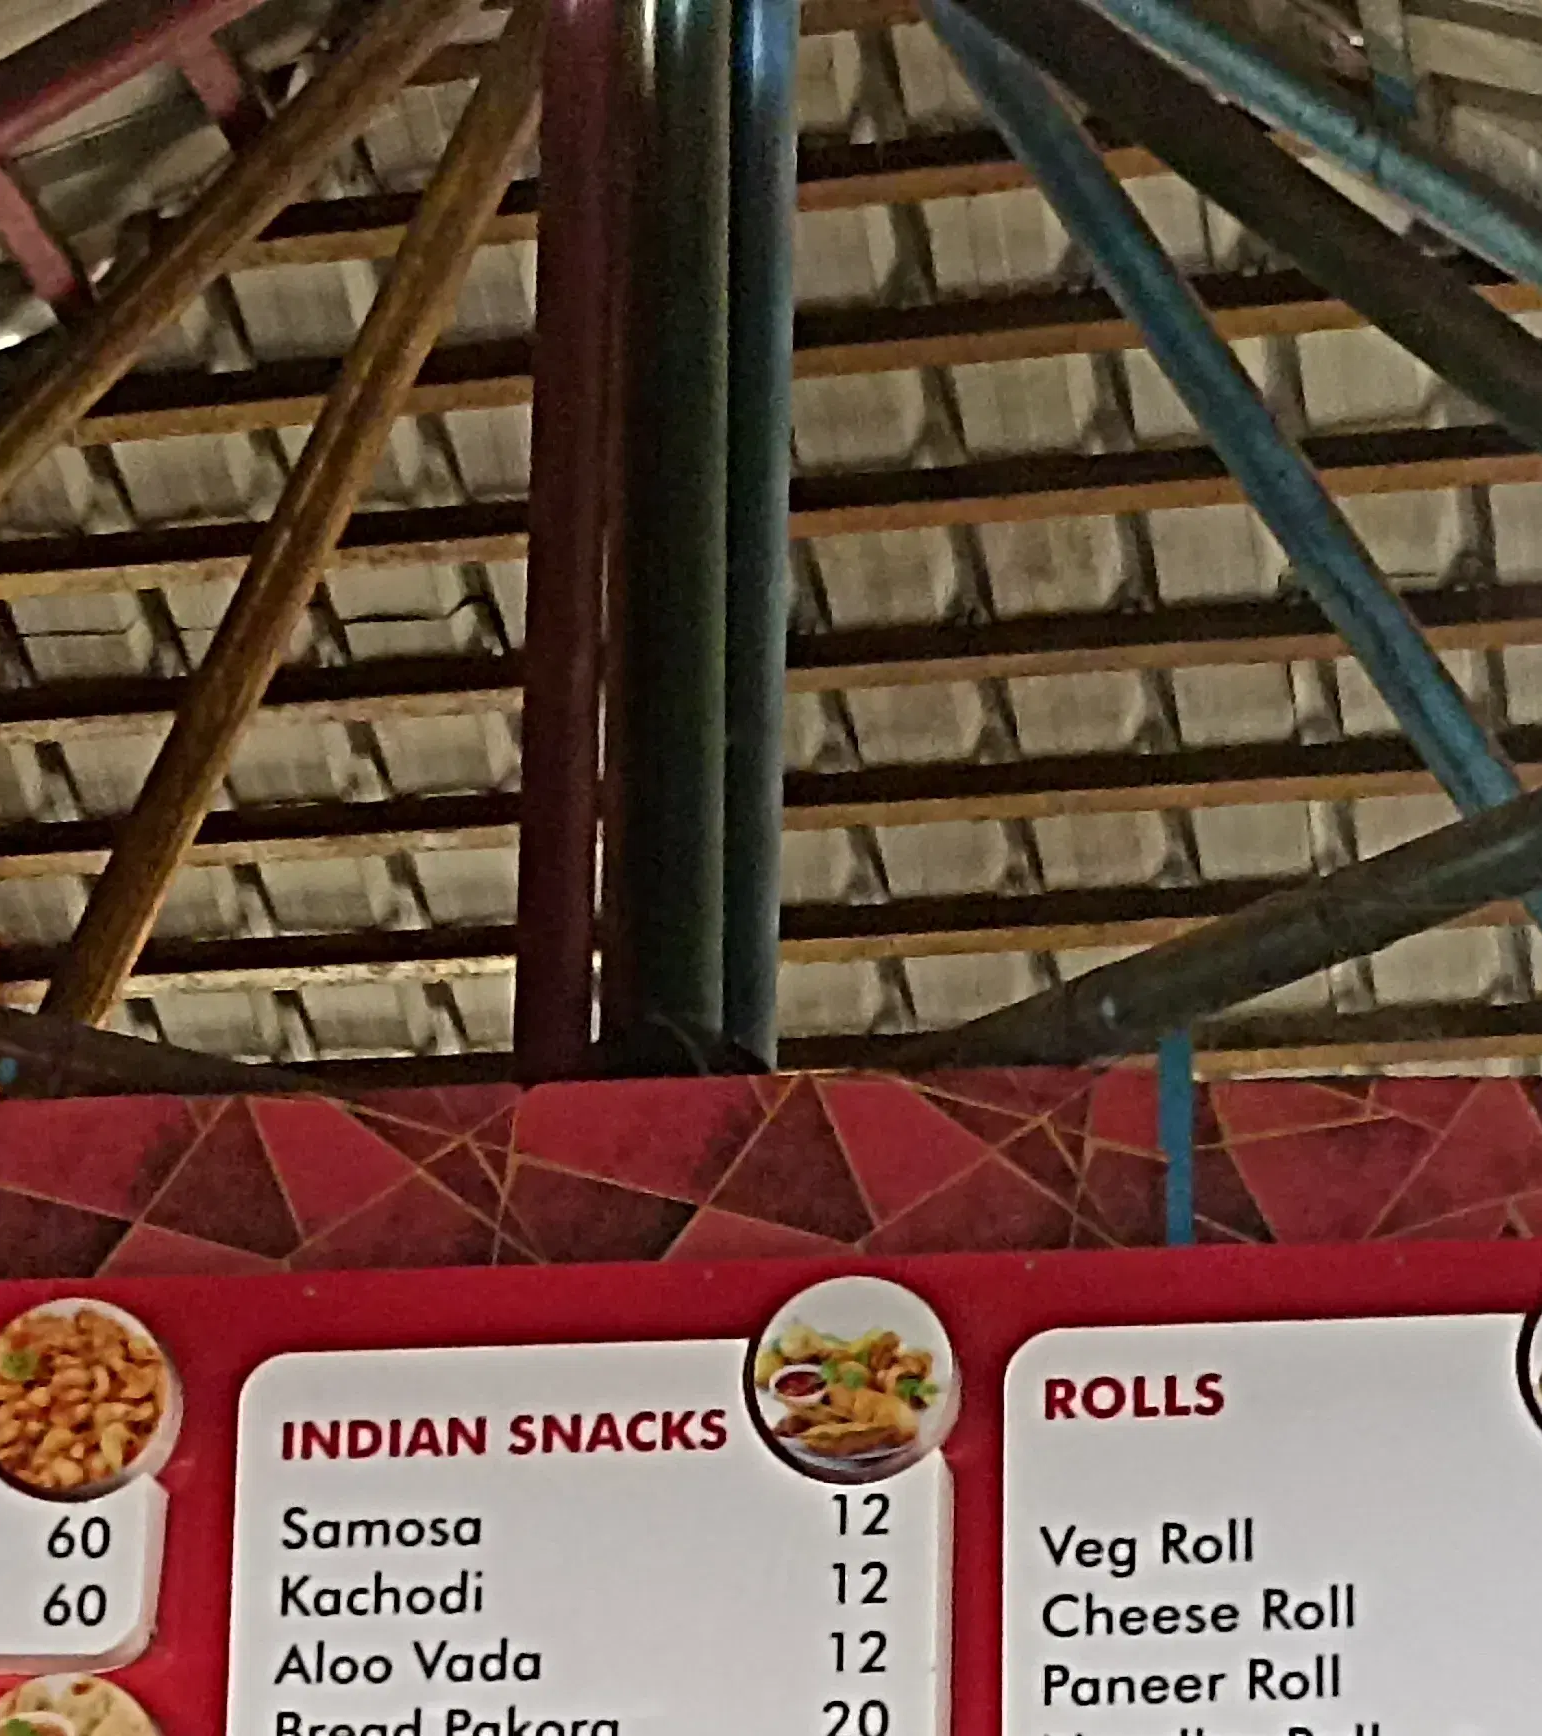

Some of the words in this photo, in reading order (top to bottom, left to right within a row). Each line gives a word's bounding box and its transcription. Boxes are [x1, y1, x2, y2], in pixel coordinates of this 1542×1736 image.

[1044, 1372, 1225, 1421] ROLLS
[281, 1416, 487, 1461] INDIAN
[507, 1408, 727, 1456] SNACKS
[47, 1515, 111, 1559] 60
[282, 1506, 482, 1550] Samosa
[832, 1493, 890, 1536] 12
[1039, 1524, 1137, 1579] Veg
[1162, 1517, 1253, 1565] Roll
[43, 1583, 107, 1627] 60
[280, 1569, 483, 1617] Kachodi
[832, 1561, 888, 1605] 12
[1042, 1592, 1240, 1638] Cheese
[1262, 1583, 1355, 1631] Roll
[273, 1640, 393, 1685] Aloo
[413, 1637, 541, 1683] Vada
[830, 1630, 887, 1674] 12
[1043, 1664, 1227, 1707] Paneer
[1249, 1653, 1340, 1701] Roll
